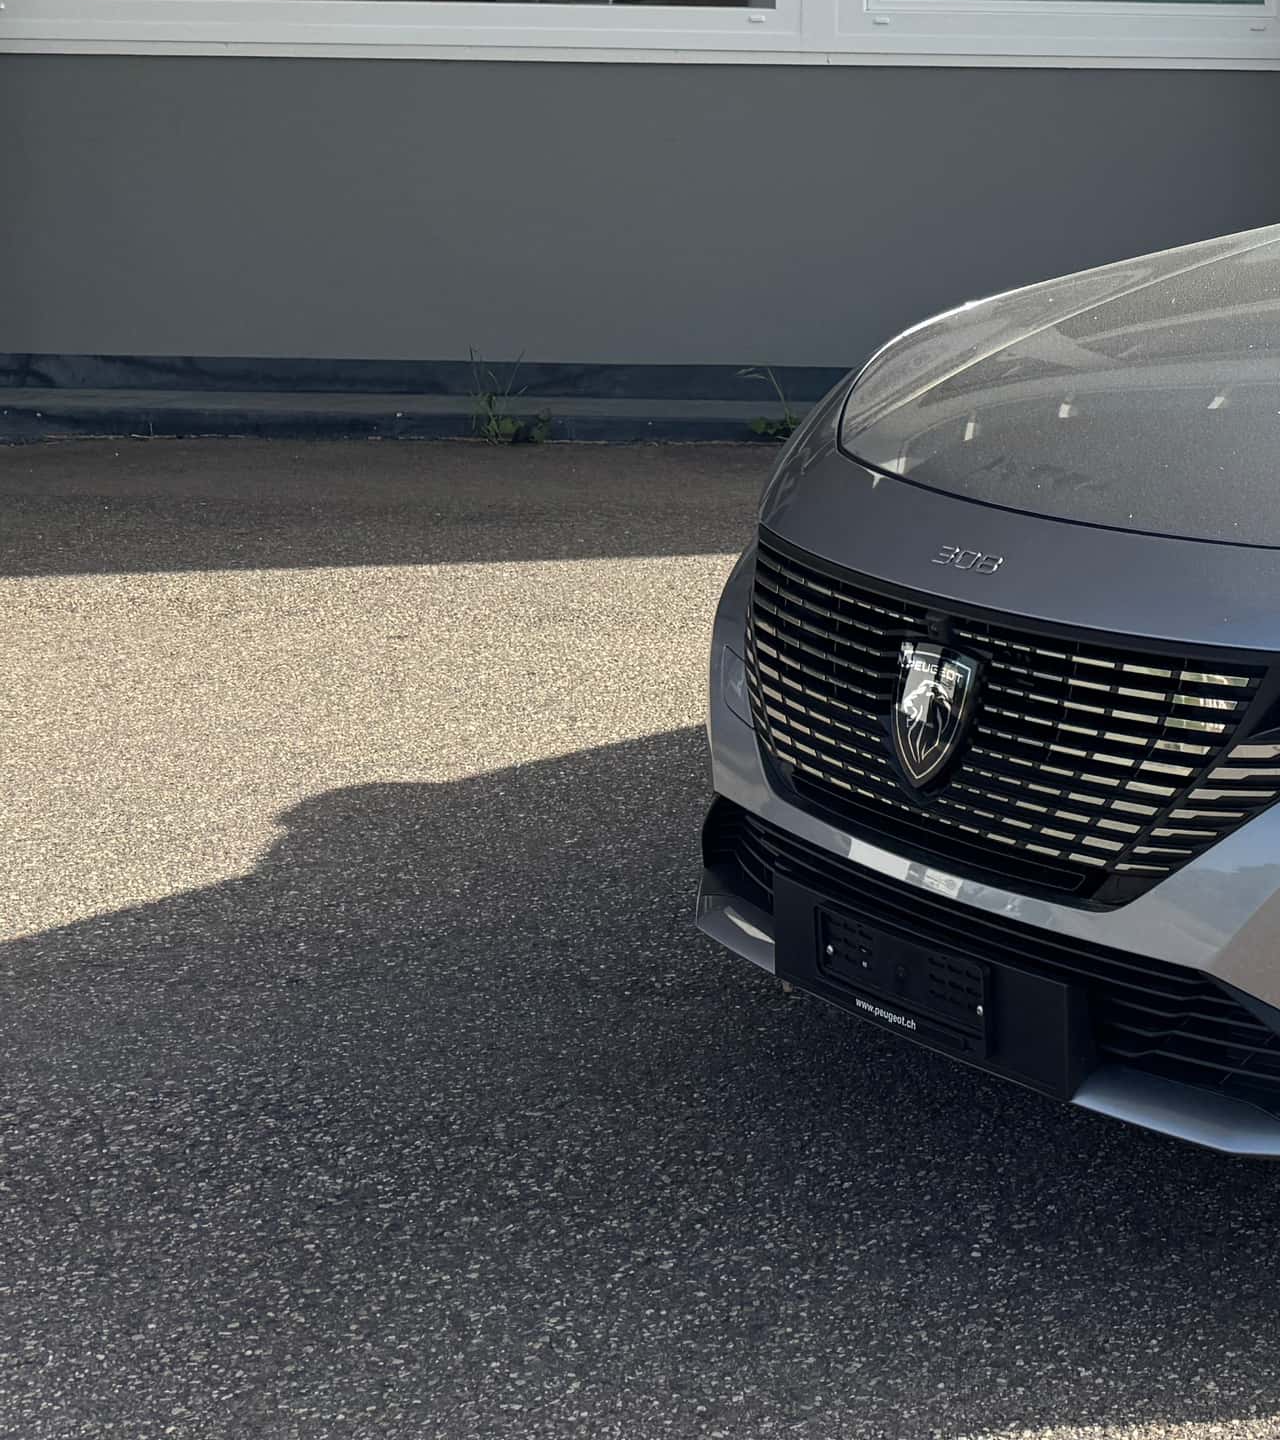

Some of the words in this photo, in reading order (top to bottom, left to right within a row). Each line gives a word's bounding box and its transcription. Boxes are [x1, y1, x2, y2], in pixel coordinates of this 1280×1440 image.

[931, 545, 1004, 574] 308
[912, 659, 964, 683] PEUGEOT
[855, 998, 917, 1031] www.peugeot.ch
